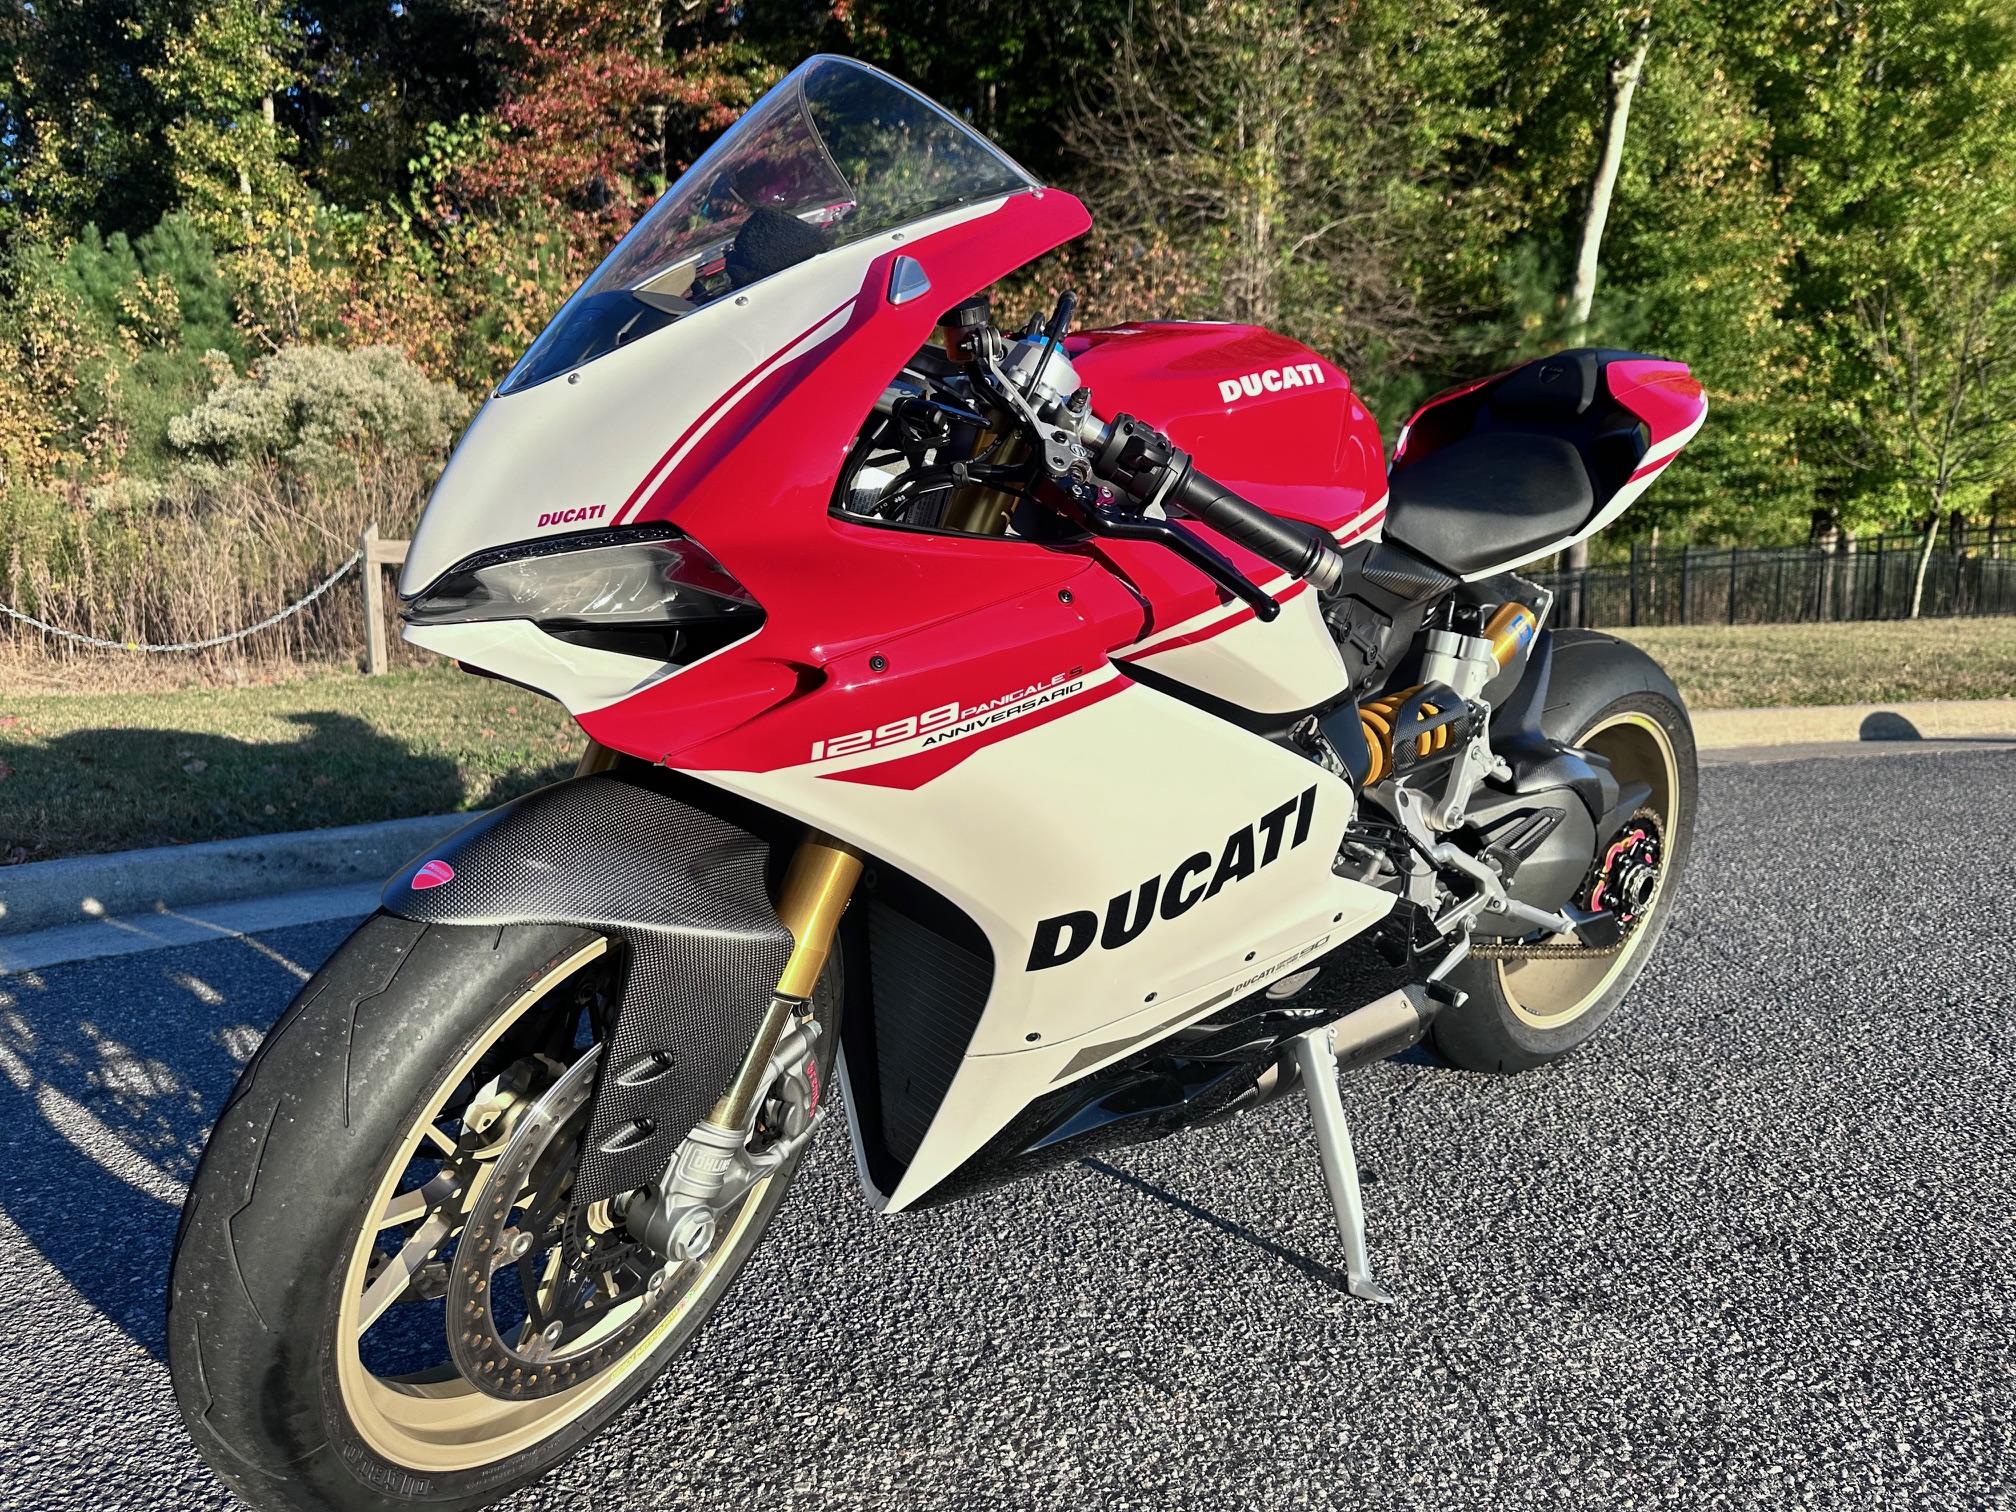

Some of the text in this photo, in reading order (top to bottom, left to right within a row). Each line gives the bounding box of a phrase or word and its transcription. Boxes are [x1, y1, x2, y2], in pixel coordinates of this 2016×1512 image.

[1218, 363, 1325, 403] DUCATI
[537, 504, 607, 528] DUCATI
[811, 665, 1083, 761] 1299 PANIGALE S
[922, 681, 1083, 748] ANNIVERSARIO
[1025, 783, 1318, 972] DUCATI
[1233, 965, 1276, 993] DUCATI
[806, 1060, 820, 1118] brembo
[343, 1444, 431, 1497] DIABLO
